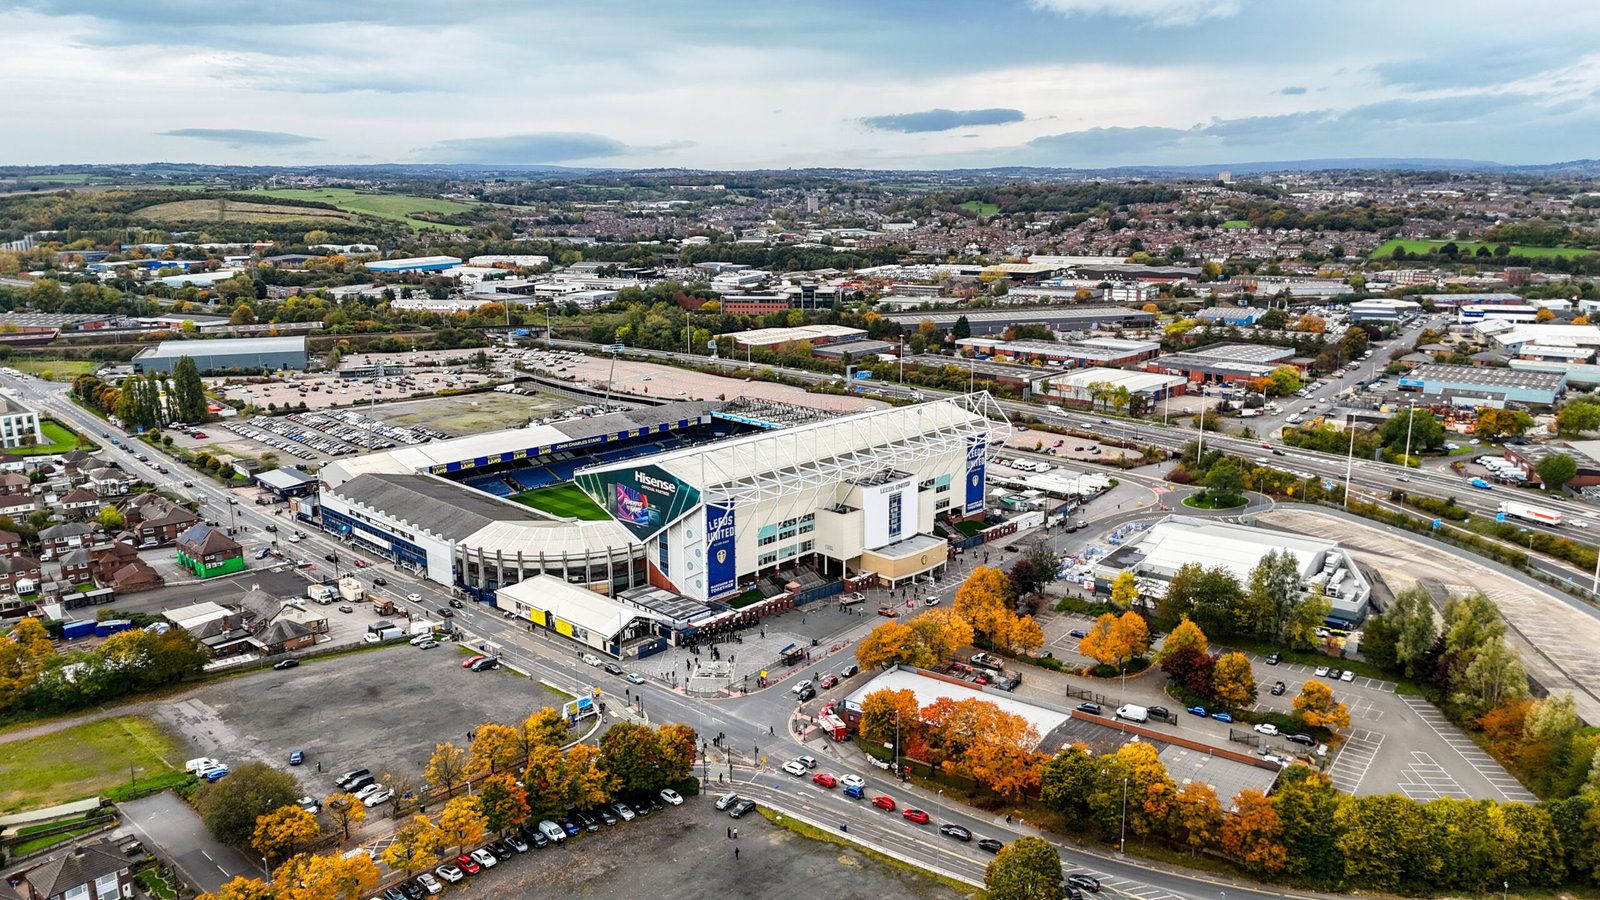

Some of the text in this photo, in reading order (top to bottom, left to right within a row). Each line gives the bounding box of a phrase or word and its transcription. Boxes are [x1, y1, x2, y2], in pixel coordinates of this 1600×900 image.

[569, 440, 587, 448] CHARLES
[588, 437, 602, 445] STAND
[635, 470, 676, 493] Hisense
[880, 480, 911, 494] LEEDS UNITED
[708, 515, 733, 531] LEEDS
[707, 526, 735, 544] UNITED
[710, 583, 734, 594] TOGETHER
